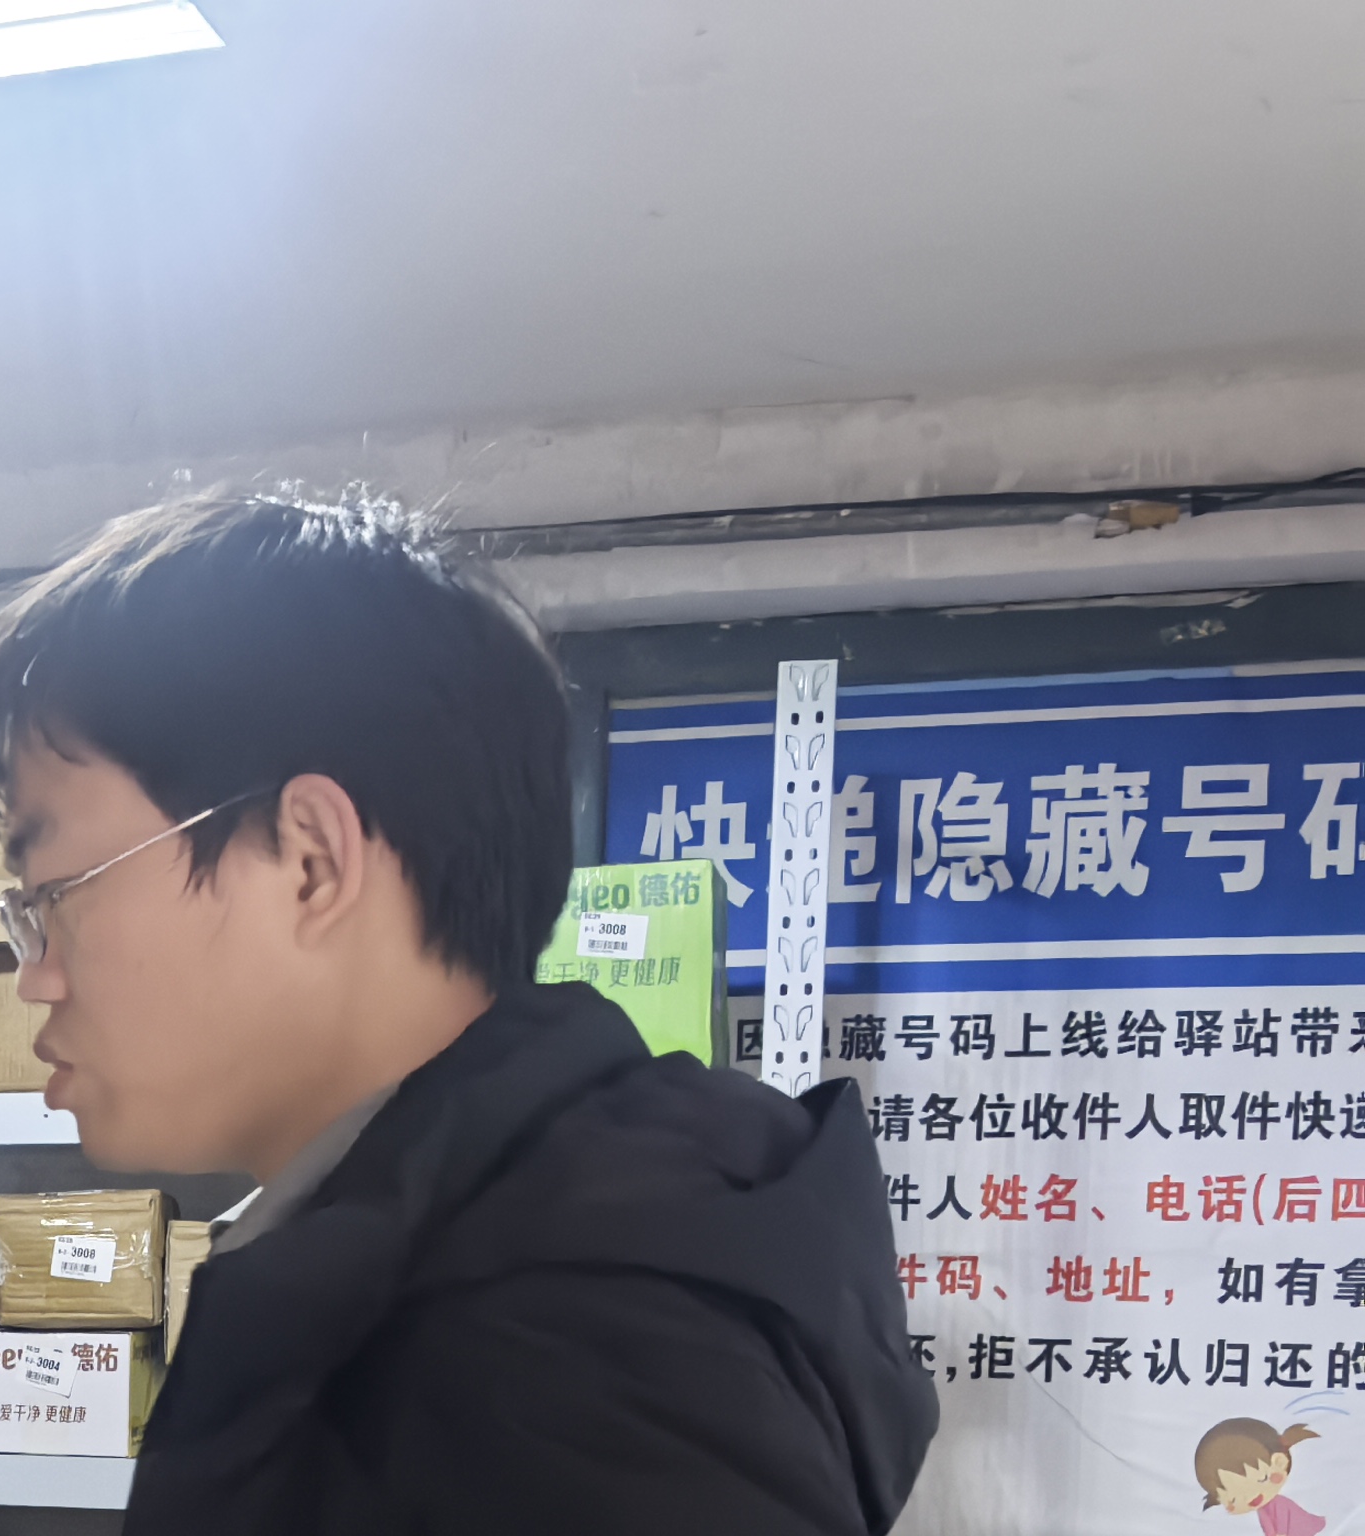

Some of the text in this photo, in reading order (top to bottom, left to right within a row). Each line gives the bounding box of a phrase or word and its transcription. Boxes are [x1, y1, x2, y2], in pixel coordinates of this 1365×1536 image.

[638, 871, 702, 908] 德佑
[598, 923, 627, 936] 3008
[608, 956, 681, 988] 更健康
[736, 1008, 1365, 1063] 因藏号码上线给驿站带
[36, 1358, 61, 1373] 3004
[71, 1343, 119, 1373] 德佑
[0, 1404, 87, 1424] 爱干净 更健康
